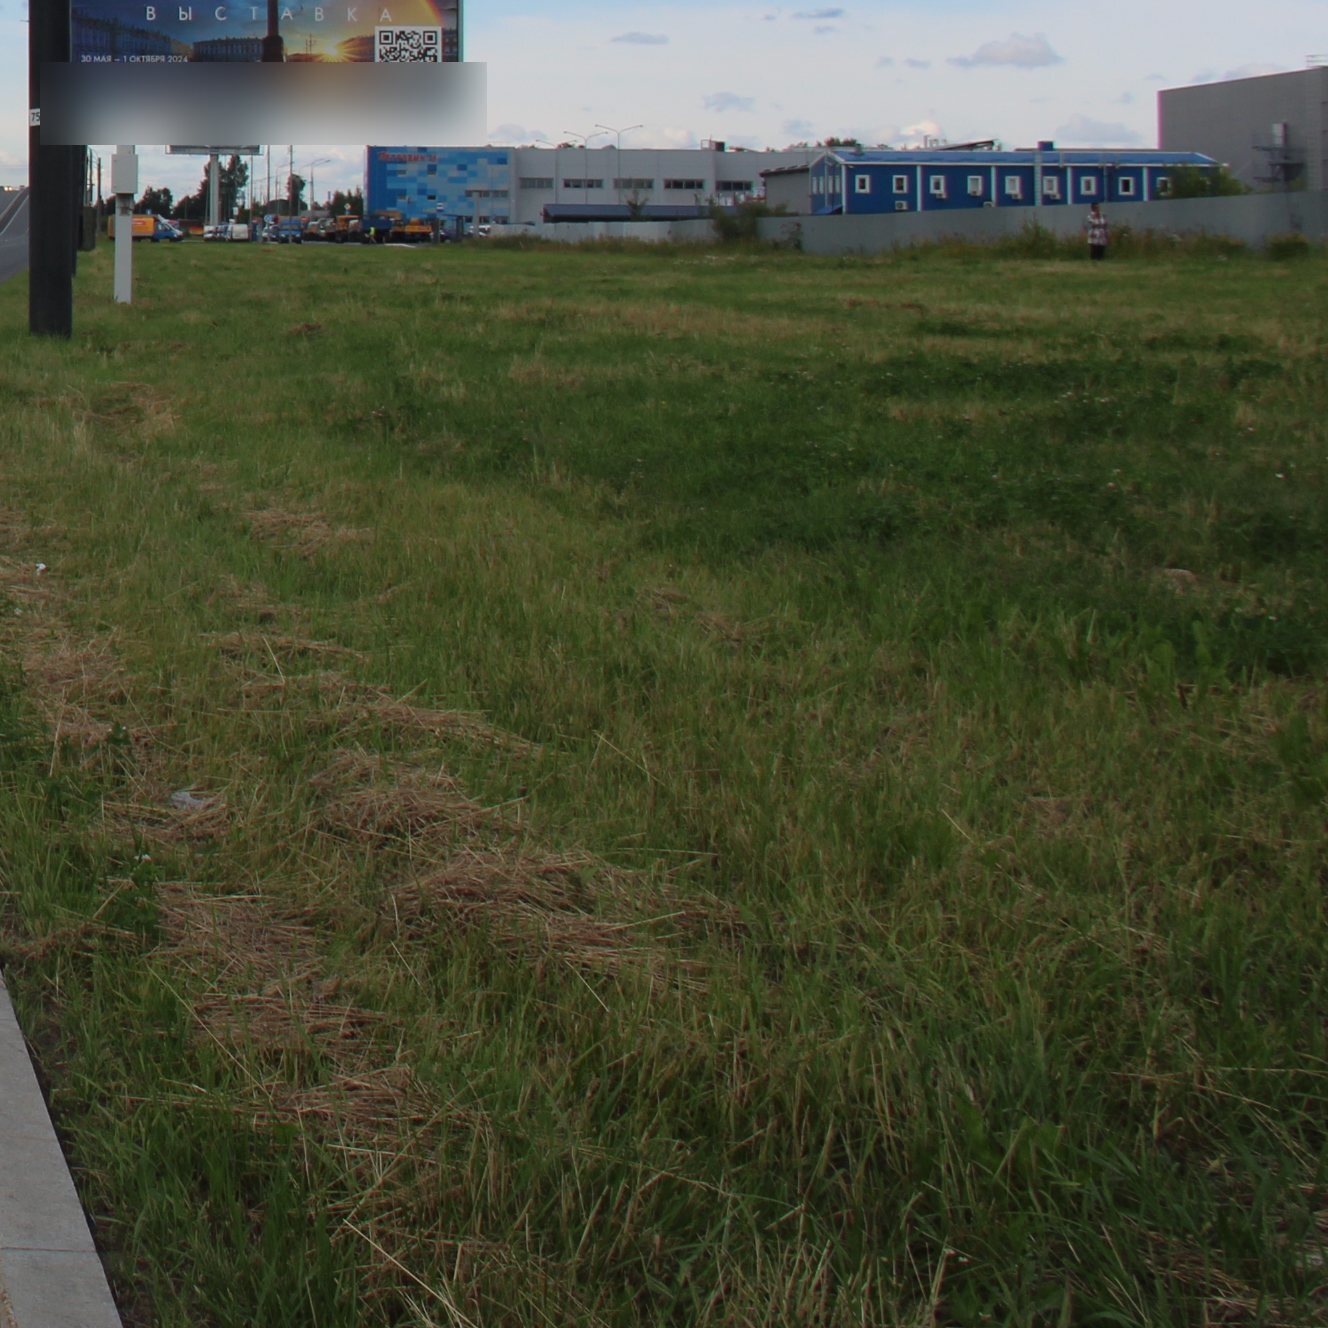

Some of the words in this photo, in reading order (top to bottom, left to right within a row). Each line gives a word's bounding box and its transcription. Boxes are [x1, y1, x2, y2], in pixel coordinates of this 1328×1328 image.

[146, 5, 393, 22] ВЫСТАВКА
[80, 54, 92, 63] 30
[93, 54, 112, 63] МАЯ
[129, 54, 166, 63] ОКТЯБРЯ
[168, 54, 189, 63] 2024
